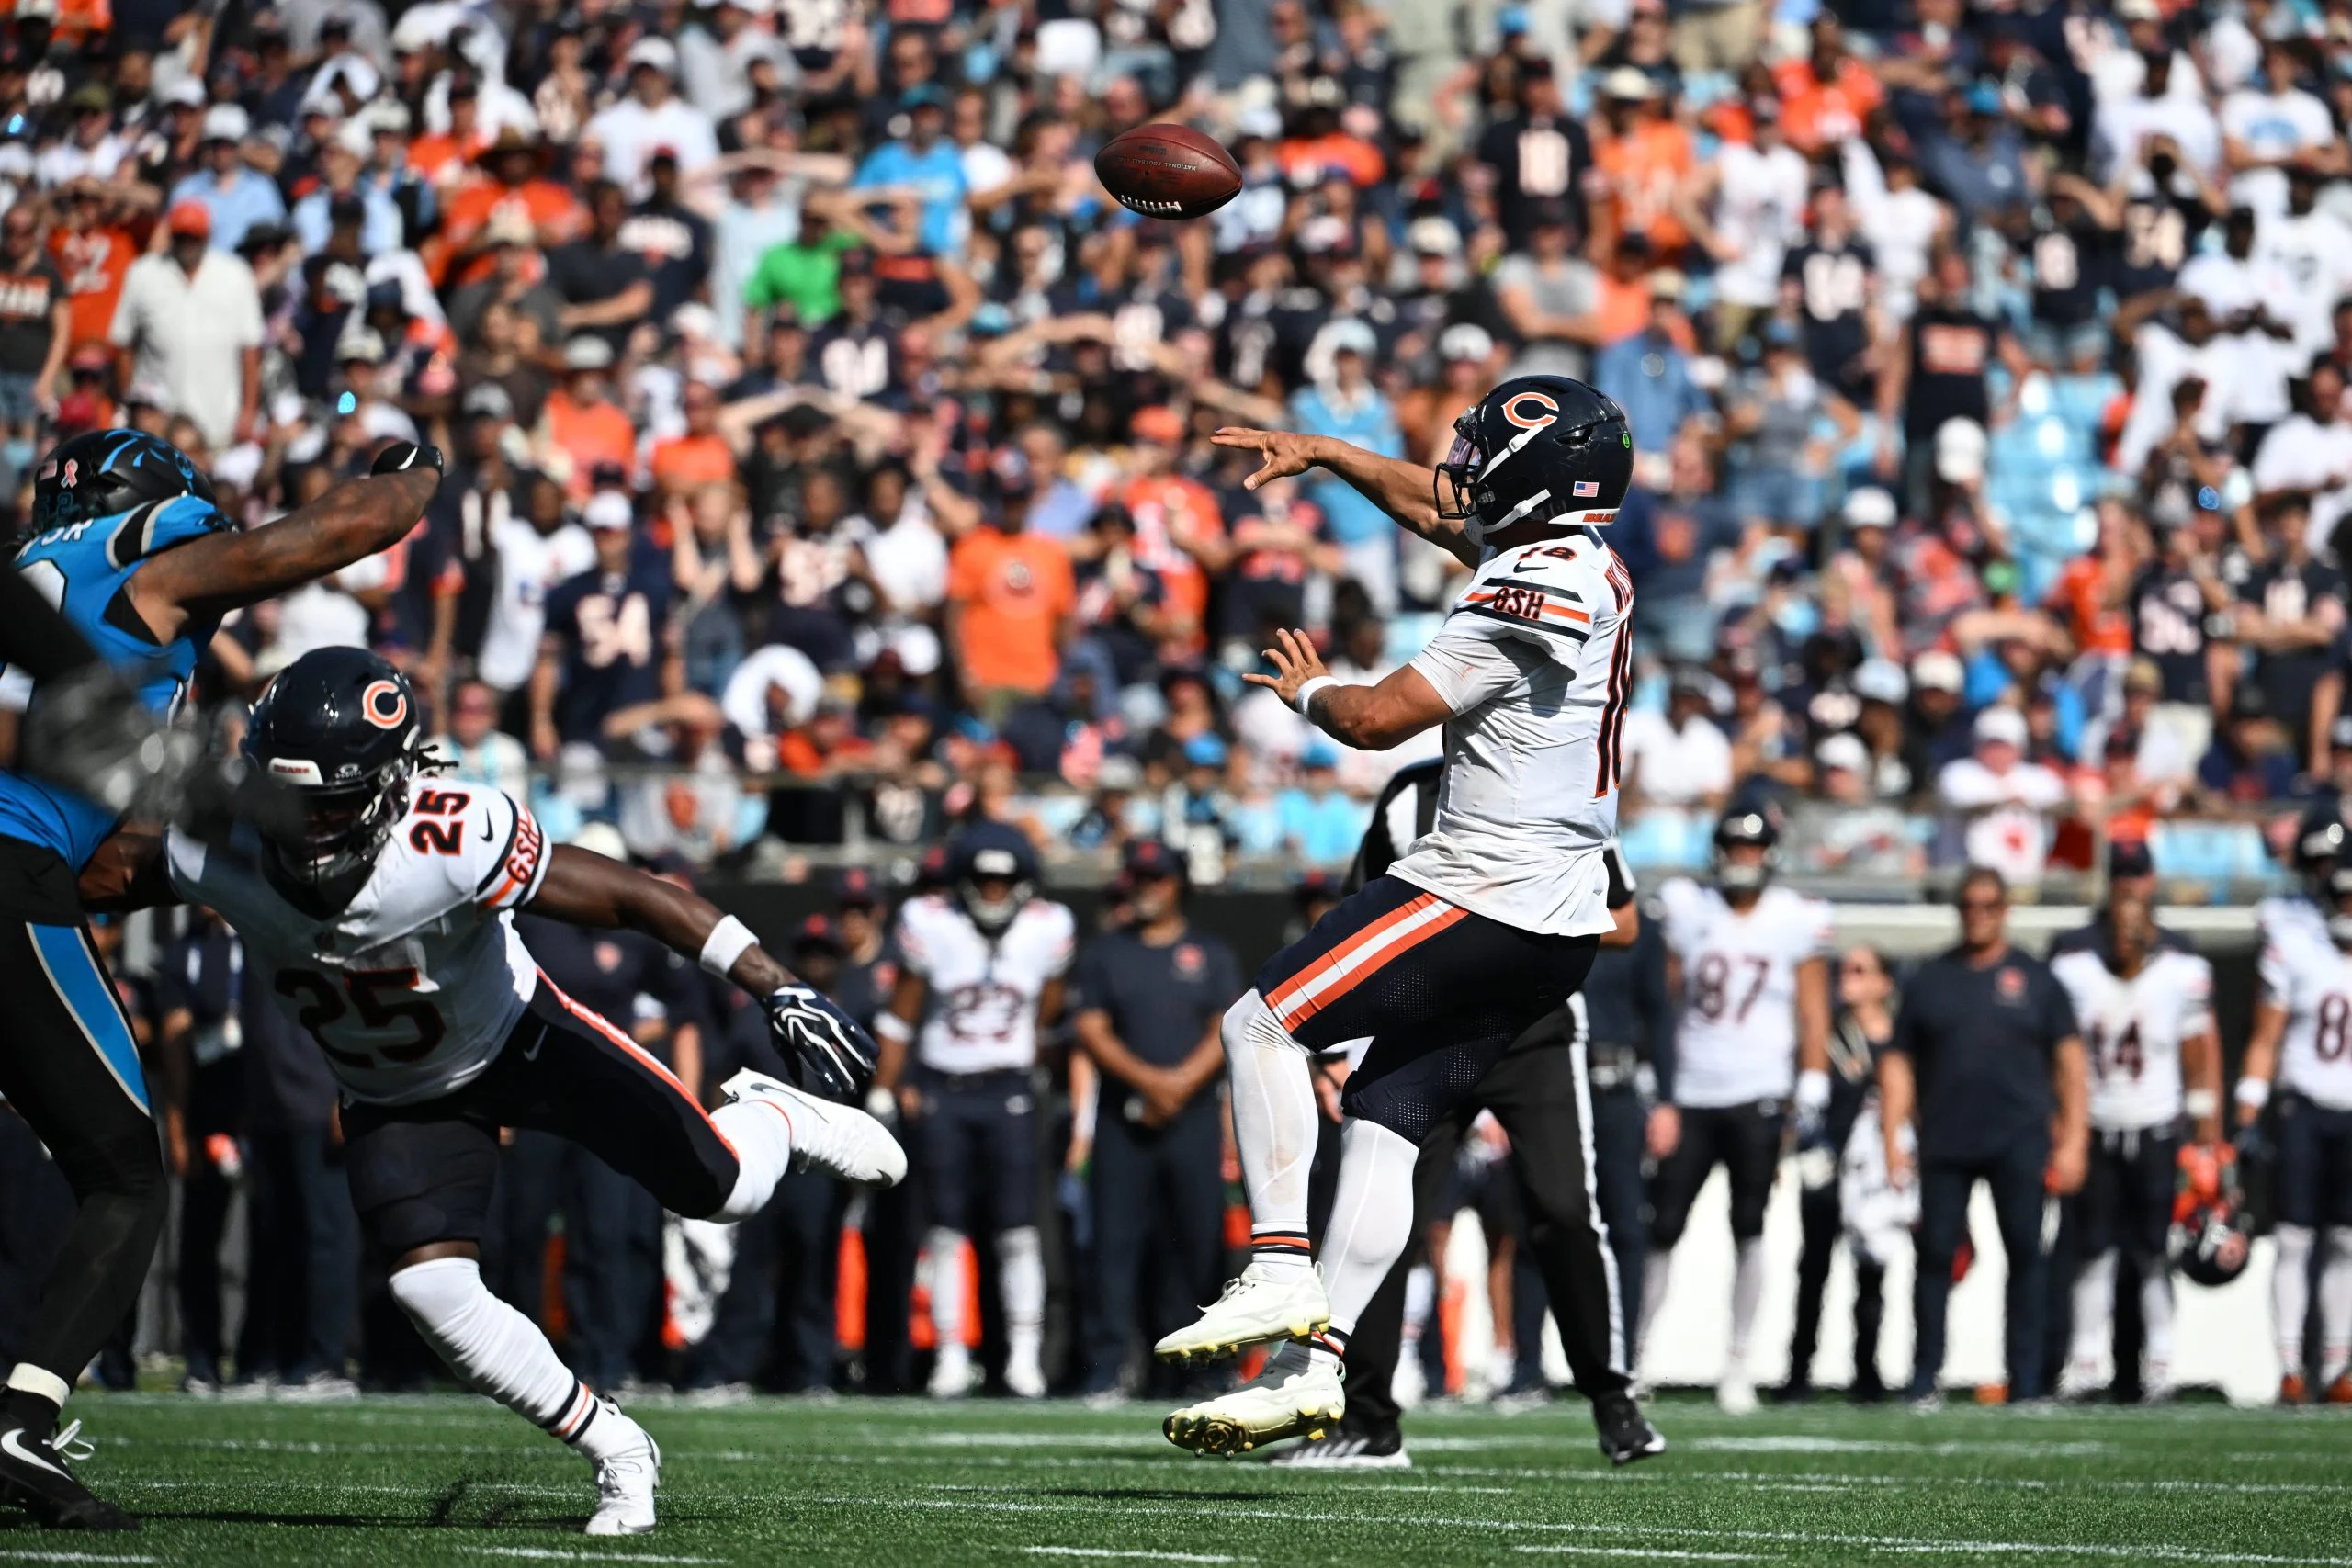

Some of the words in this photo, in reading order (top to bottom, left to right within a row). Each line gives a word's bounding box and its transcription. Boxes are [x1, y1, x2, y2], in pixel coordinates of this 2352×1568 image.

[1164, 162, 1197, 171] NATIONAL
[1492, 585, 1547, 622] GSH
[409, 789, 471, 858] 25
[504, 806, 540, 885] GSH
[274, 966, 447, 1070] 25
[1698, 951, 1770, 1025] 87
[2090, 1018, 2143, 1082] 14
[2315, 991, 2352, 1064] 8
